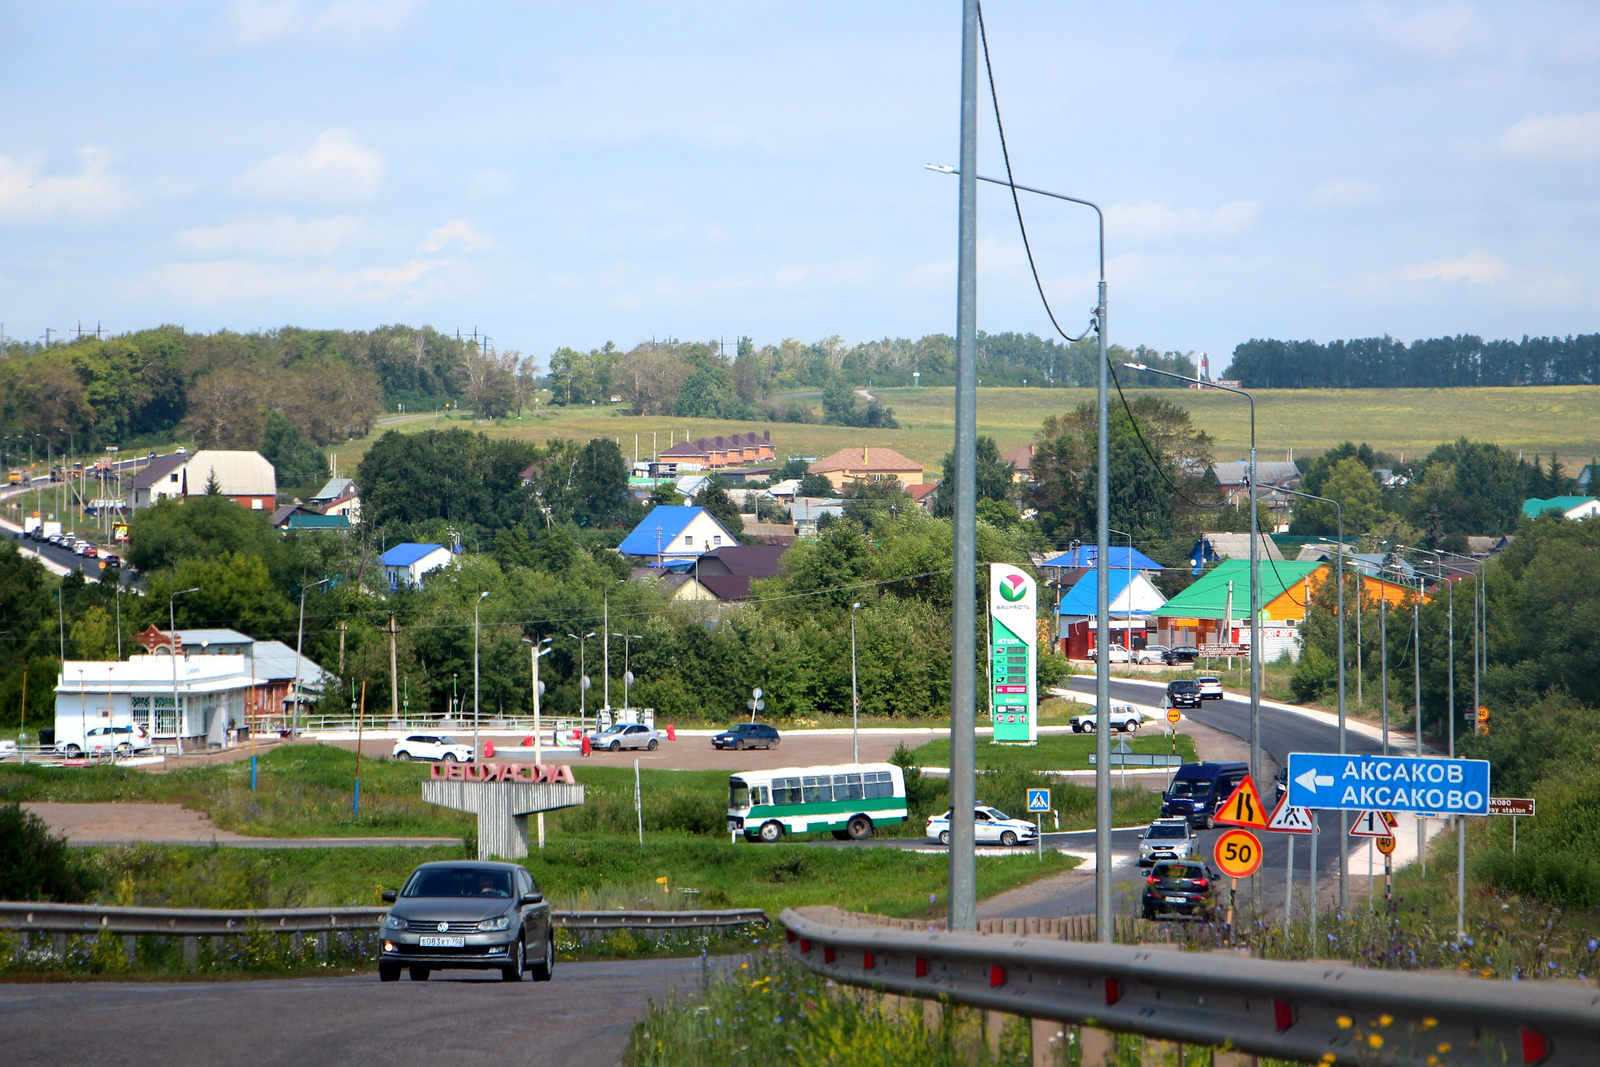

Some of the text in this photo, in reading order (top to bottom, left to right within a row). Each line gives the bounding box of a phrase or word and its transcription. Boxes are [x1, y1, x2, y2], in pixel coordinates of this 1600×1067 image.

[1341, 761, 1464, 784] АКСАКОВ
[1341, 785, 1484, 810] АКСАКОВО
[1224, 842, 1252, 863] 50
[1380, 837, 1391, 847] 40
